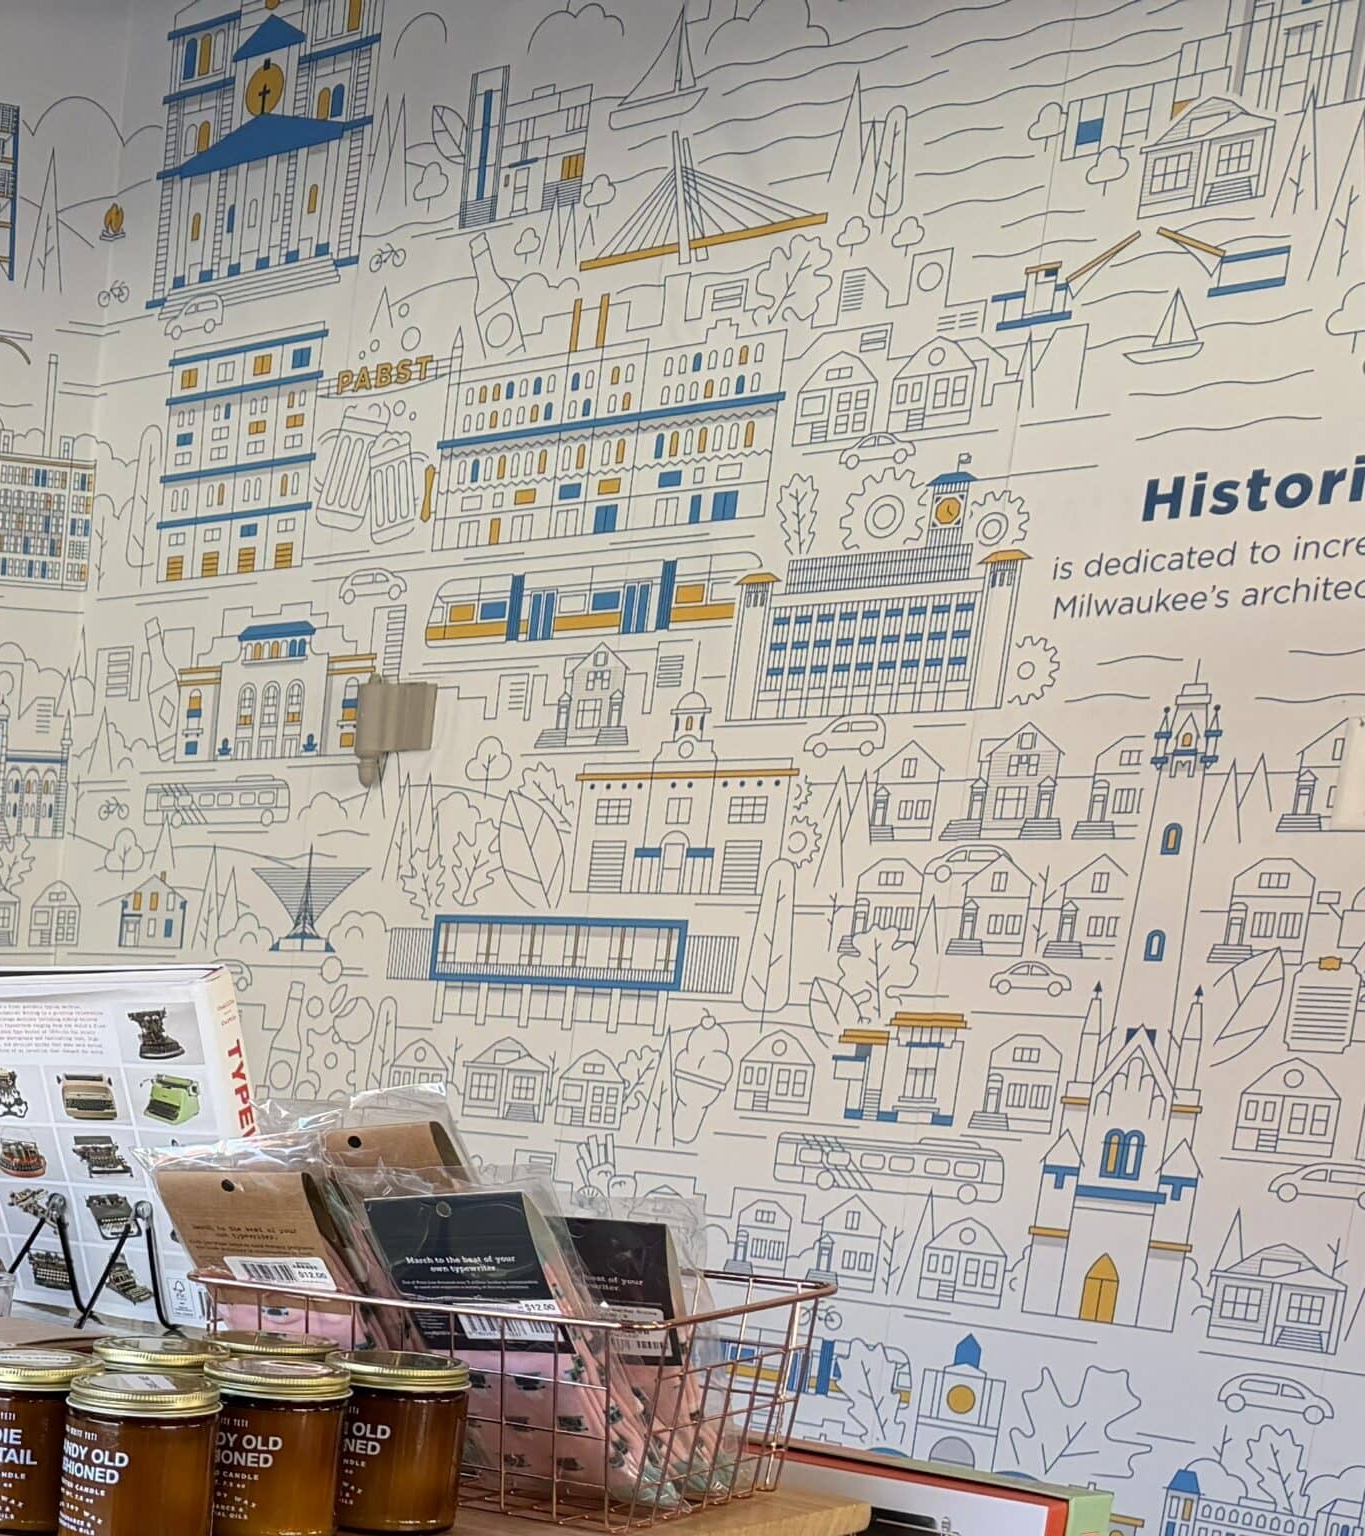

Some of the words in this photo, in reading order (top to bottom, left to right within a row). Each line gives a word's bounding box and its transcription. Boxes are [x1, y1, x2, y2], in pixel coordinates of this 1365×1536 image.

[336, 354, 434, 395] PABST
[1141, 454, 1365, 522] Histori
[1052, 556, 1073, 580] is
[1084, 540, 1237, 578] dedicated
[1249, 541, 1280, 565] to
[1052, 584, 1229, 619] Milwaukee's
[405, 1256, 433, 1265] March
[434, 1256, 445, 1265] to
[446, 1256, 460, 1265] the
[461, 1255, 482, 1264] beat
[483, 1255, 493, 1264] of
[495, 1255, 516, 1265] your
[430, 1265, 449, 1273] own
[352, 1422, 391, 1440] OLD
[242, 1435, 283, 1451] OLD
[91, 1449, 130, 1468] OLD
